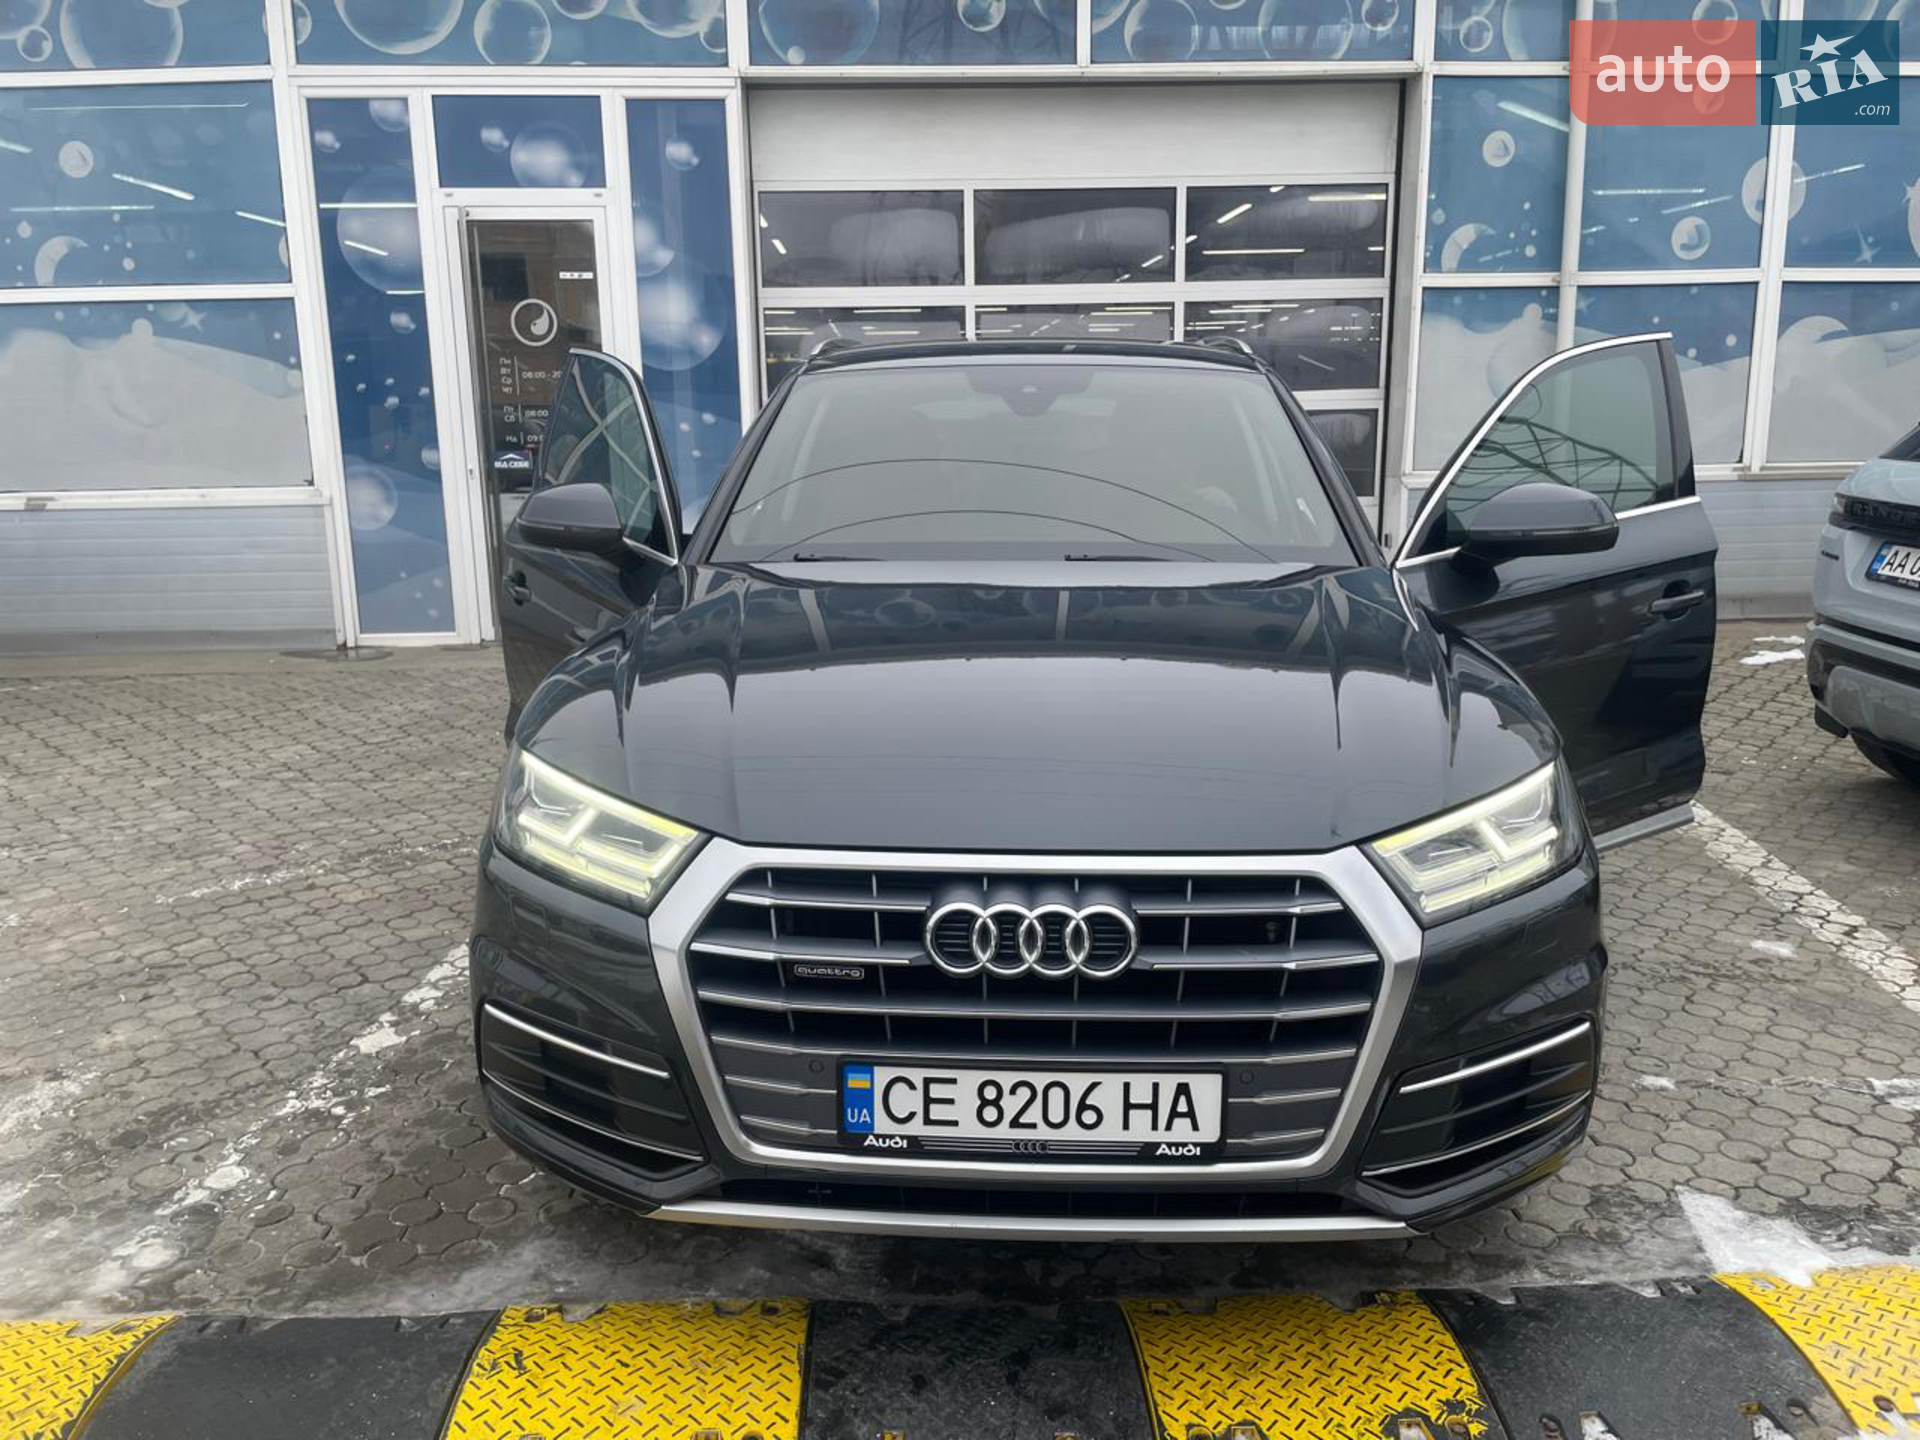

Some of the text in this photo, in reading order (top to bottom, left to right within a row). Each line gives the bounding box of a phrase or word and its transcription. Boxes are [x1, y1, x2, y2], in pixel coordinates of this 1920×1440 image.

[797, 966, 861, 978] quattro
[881, 1074, 1200, 1132] CE 8206 HA
[847, 1107, 871, 1124] UA
[863, 1134, 907, 1149] Audi
[1155, 1142, 1201, 1157] Audi
